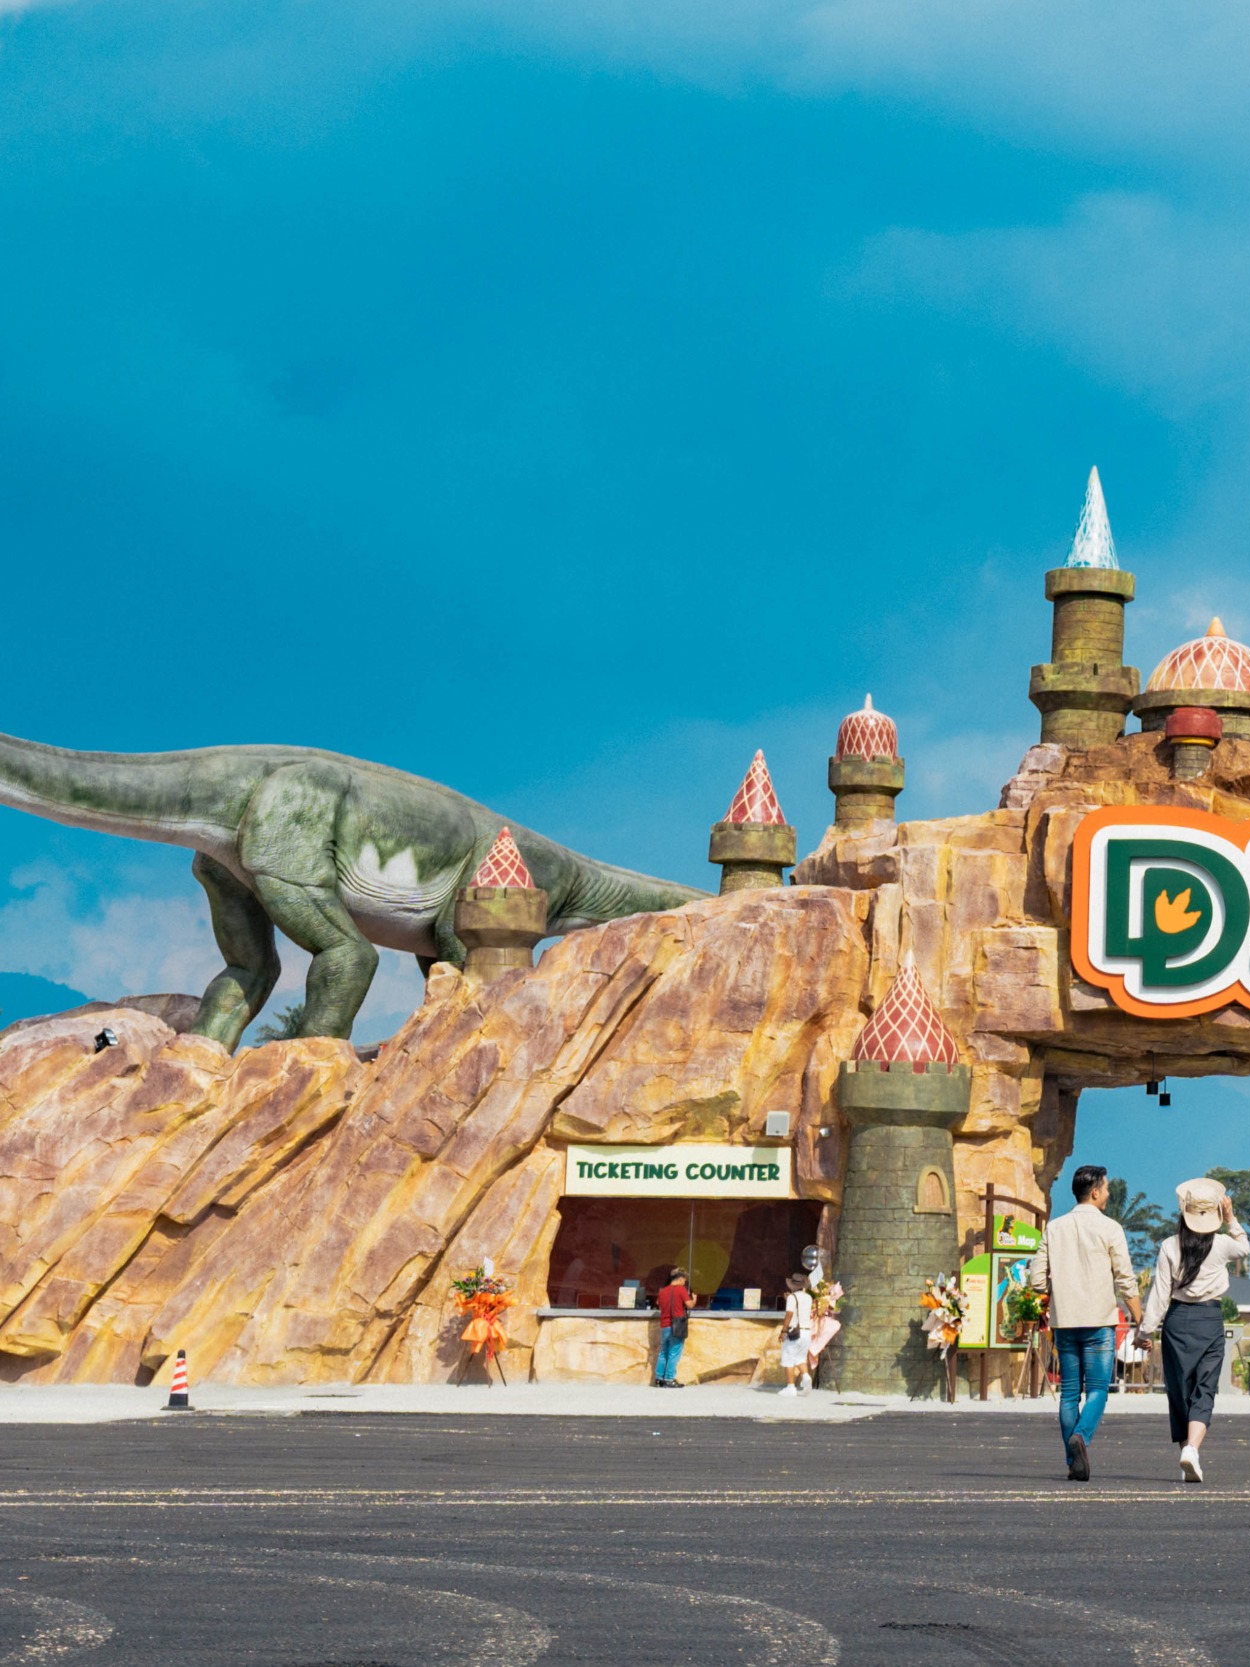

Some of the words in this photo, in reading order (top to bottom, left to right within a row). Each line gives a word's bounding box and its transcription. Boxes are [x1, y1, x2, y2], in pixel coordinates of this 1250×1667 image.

[576, 1161, 678, 1180] TICKETING
[685, 1163, 780, 1181] COUNTER
[1017, 1234, 1036, 1249] Map
